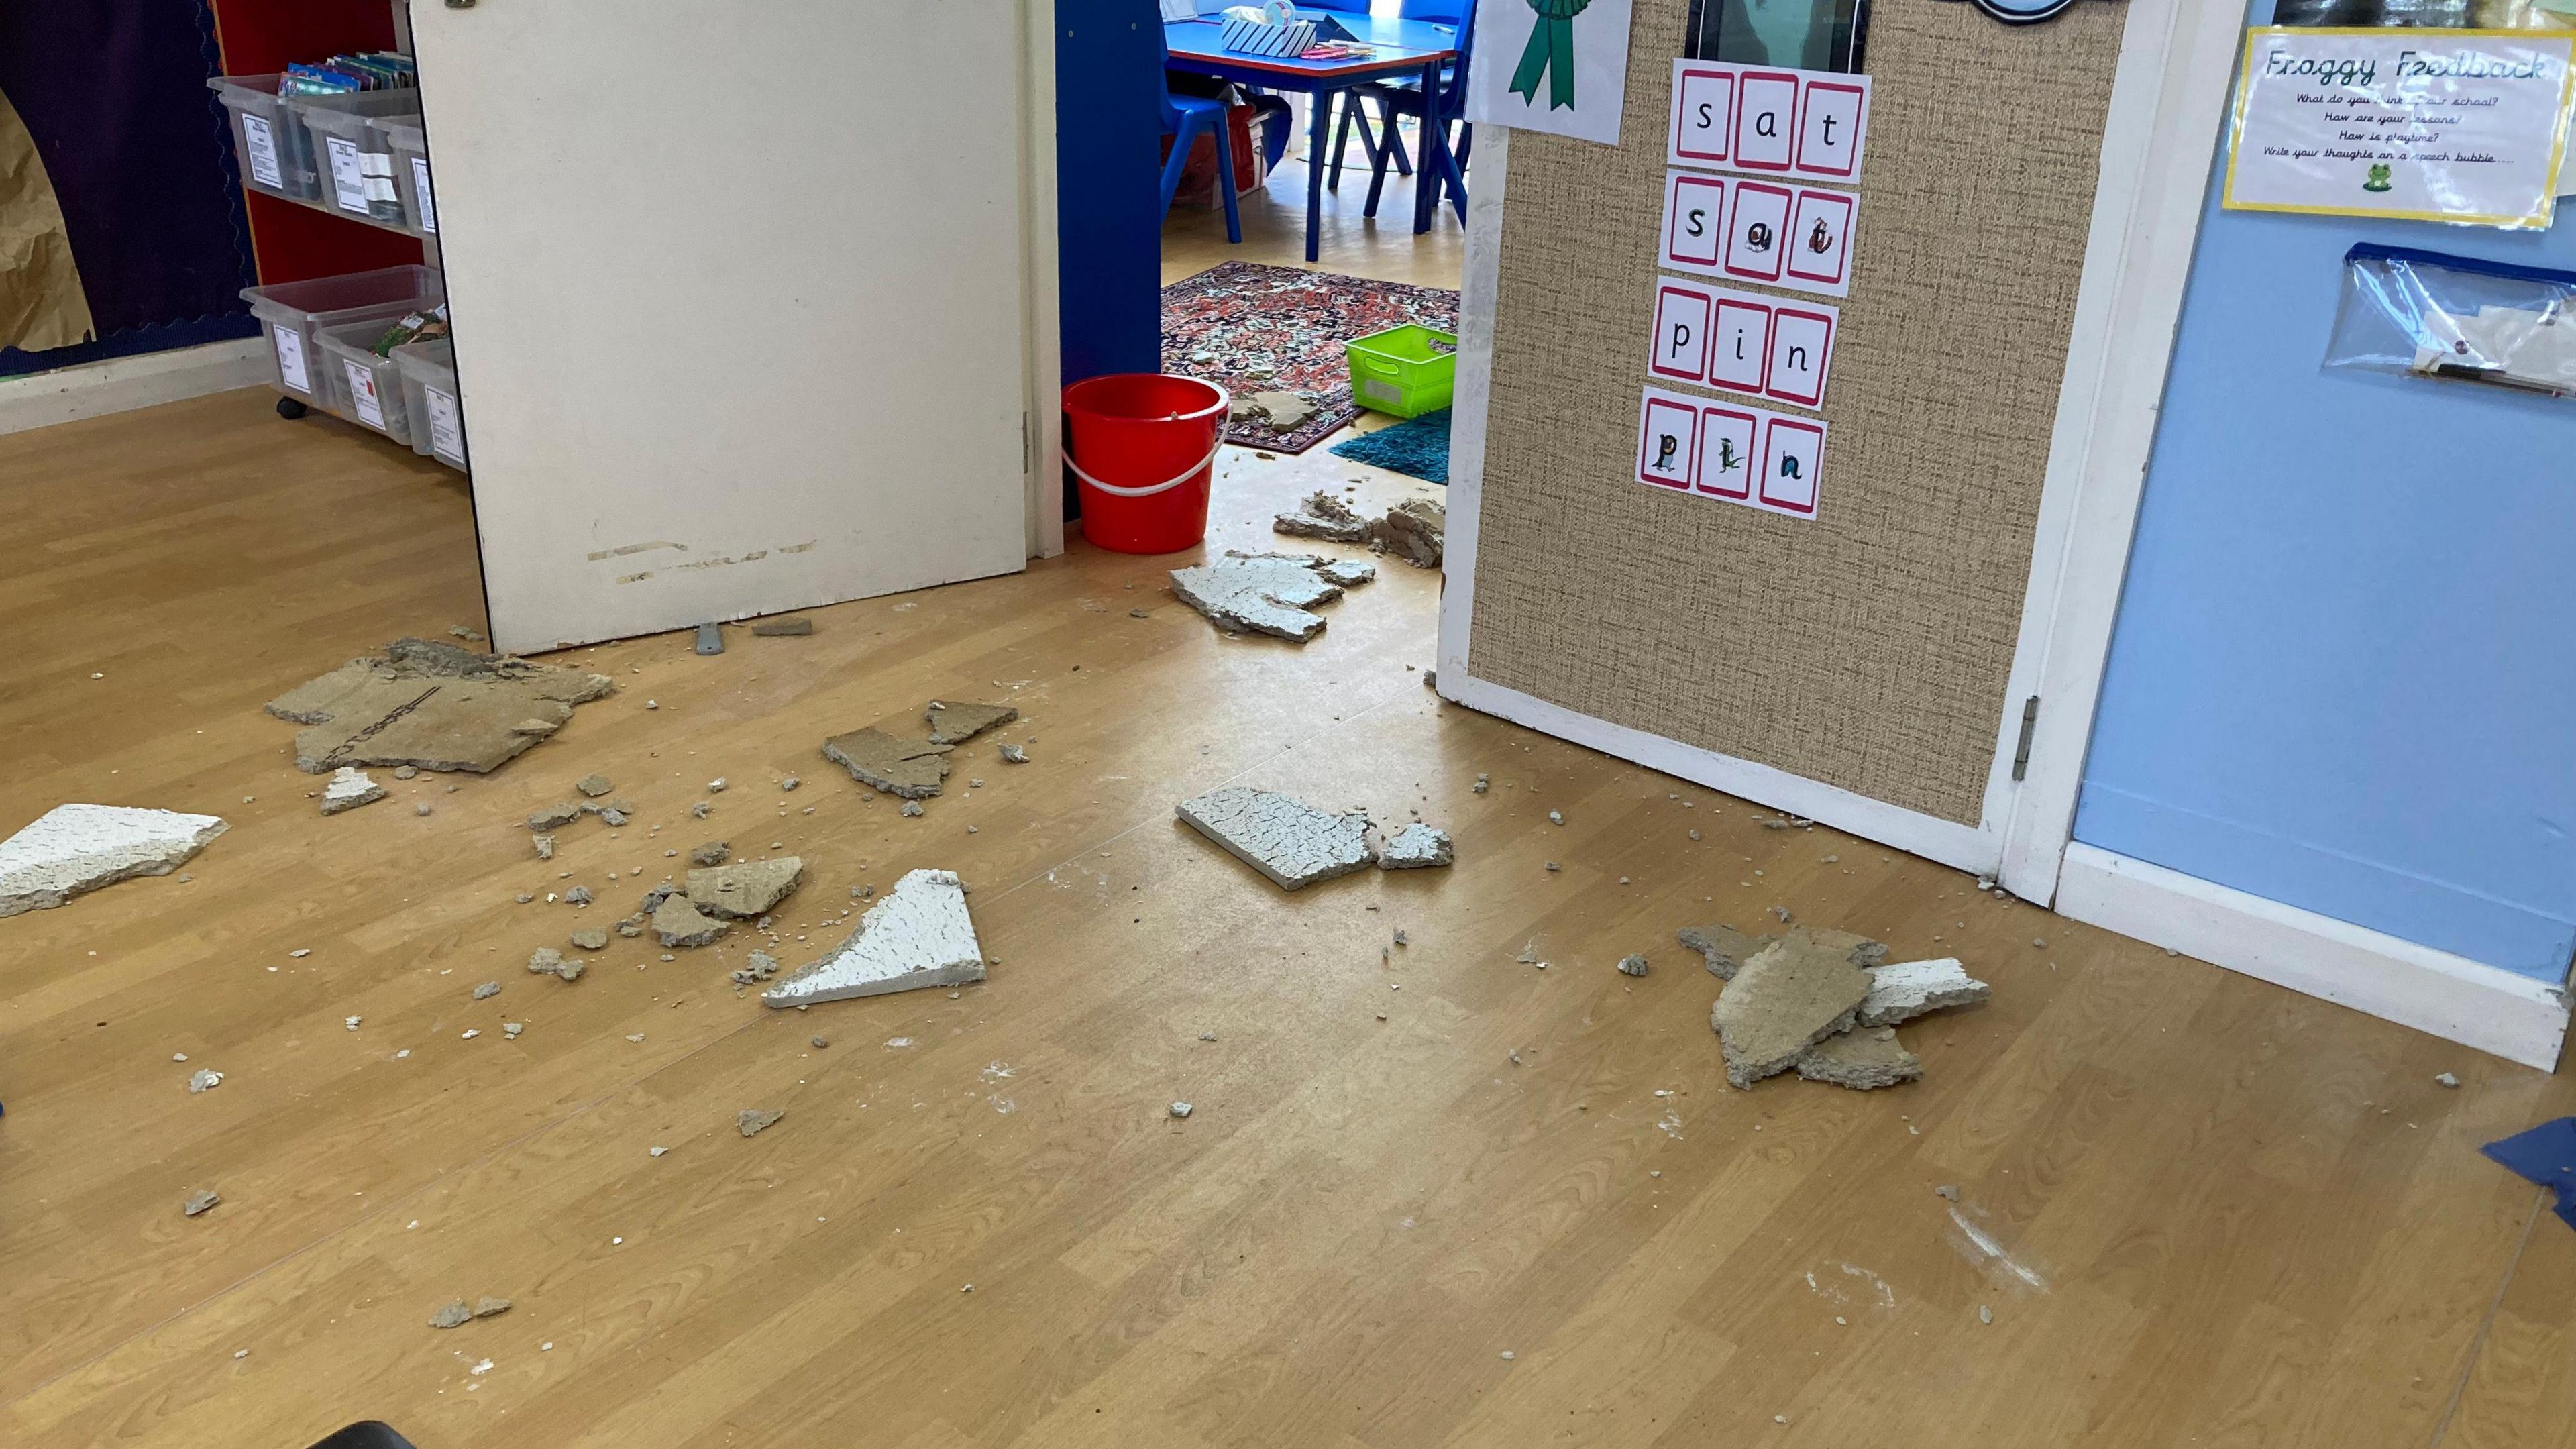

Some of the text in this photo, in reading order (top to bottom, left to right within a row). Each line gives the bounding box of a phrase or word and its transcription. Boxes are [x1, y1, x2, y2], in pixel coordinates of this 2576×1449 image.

[2266, 50, 2545, 87] Froggy Feedback
[2296, 93, 2324, 103] What
[2327, 94, 2343, 103] do
[2347, 97, 2371, 107] you
[2374, 94, 2403, 105] ink
[2451, 96, 2499, 107] school?
[2324, 111, 2350, 122] How
[2377, 116, 2406, 126] your
[2339, 129, 2440, 145] How is playtime?
[2263, 146, 2290, 156] Write
[2292, 150, 2319, 160] your
[2323, 148, 2373, 162] thoughts
[2377, 152, 2394, 160] on
[2398, 152, 2408, 160] a
[2411, 152, 2451, 163] speech
